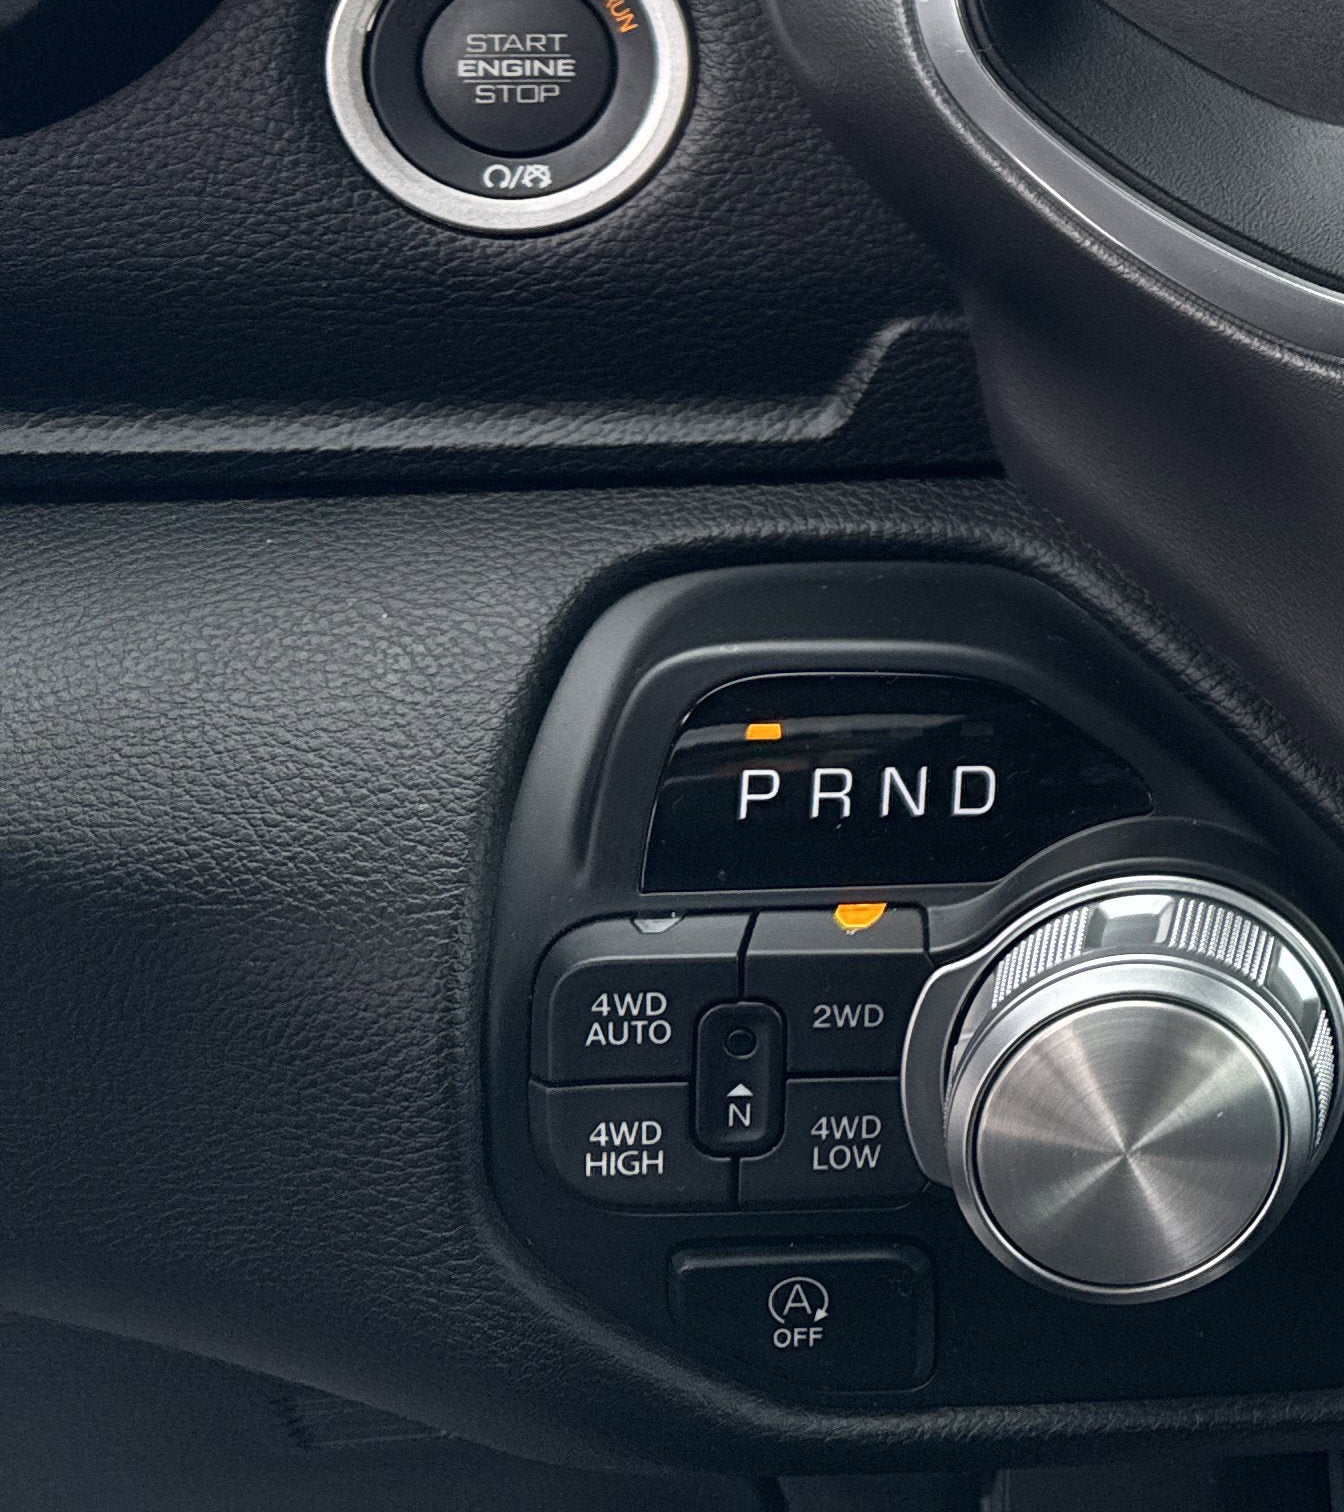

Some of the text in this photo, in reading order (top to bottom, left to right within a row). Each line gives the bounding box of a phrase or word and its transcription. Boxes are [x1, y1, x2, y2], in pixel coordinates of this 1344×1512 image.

[466, 34, 569, 52] START
[457, 59, 577, 77] ENGINE
[475, 84, 560, 104] STOP
[591, 992, 668, 1016] 4WD
[813, 1004, 884, 1029] 2WD
[585, 1020, 672, 1047] AUTO
[728, 1102, 751, 1128] N
[810, 1115, 882, 1140] 4WD
[589, 1120, 662, 1147] 4WD
[585, 1150, 664, 1177] HIGH
[813, 1145, 881, 1171] LOW
[773, 1327, 823, 1348] OFF
